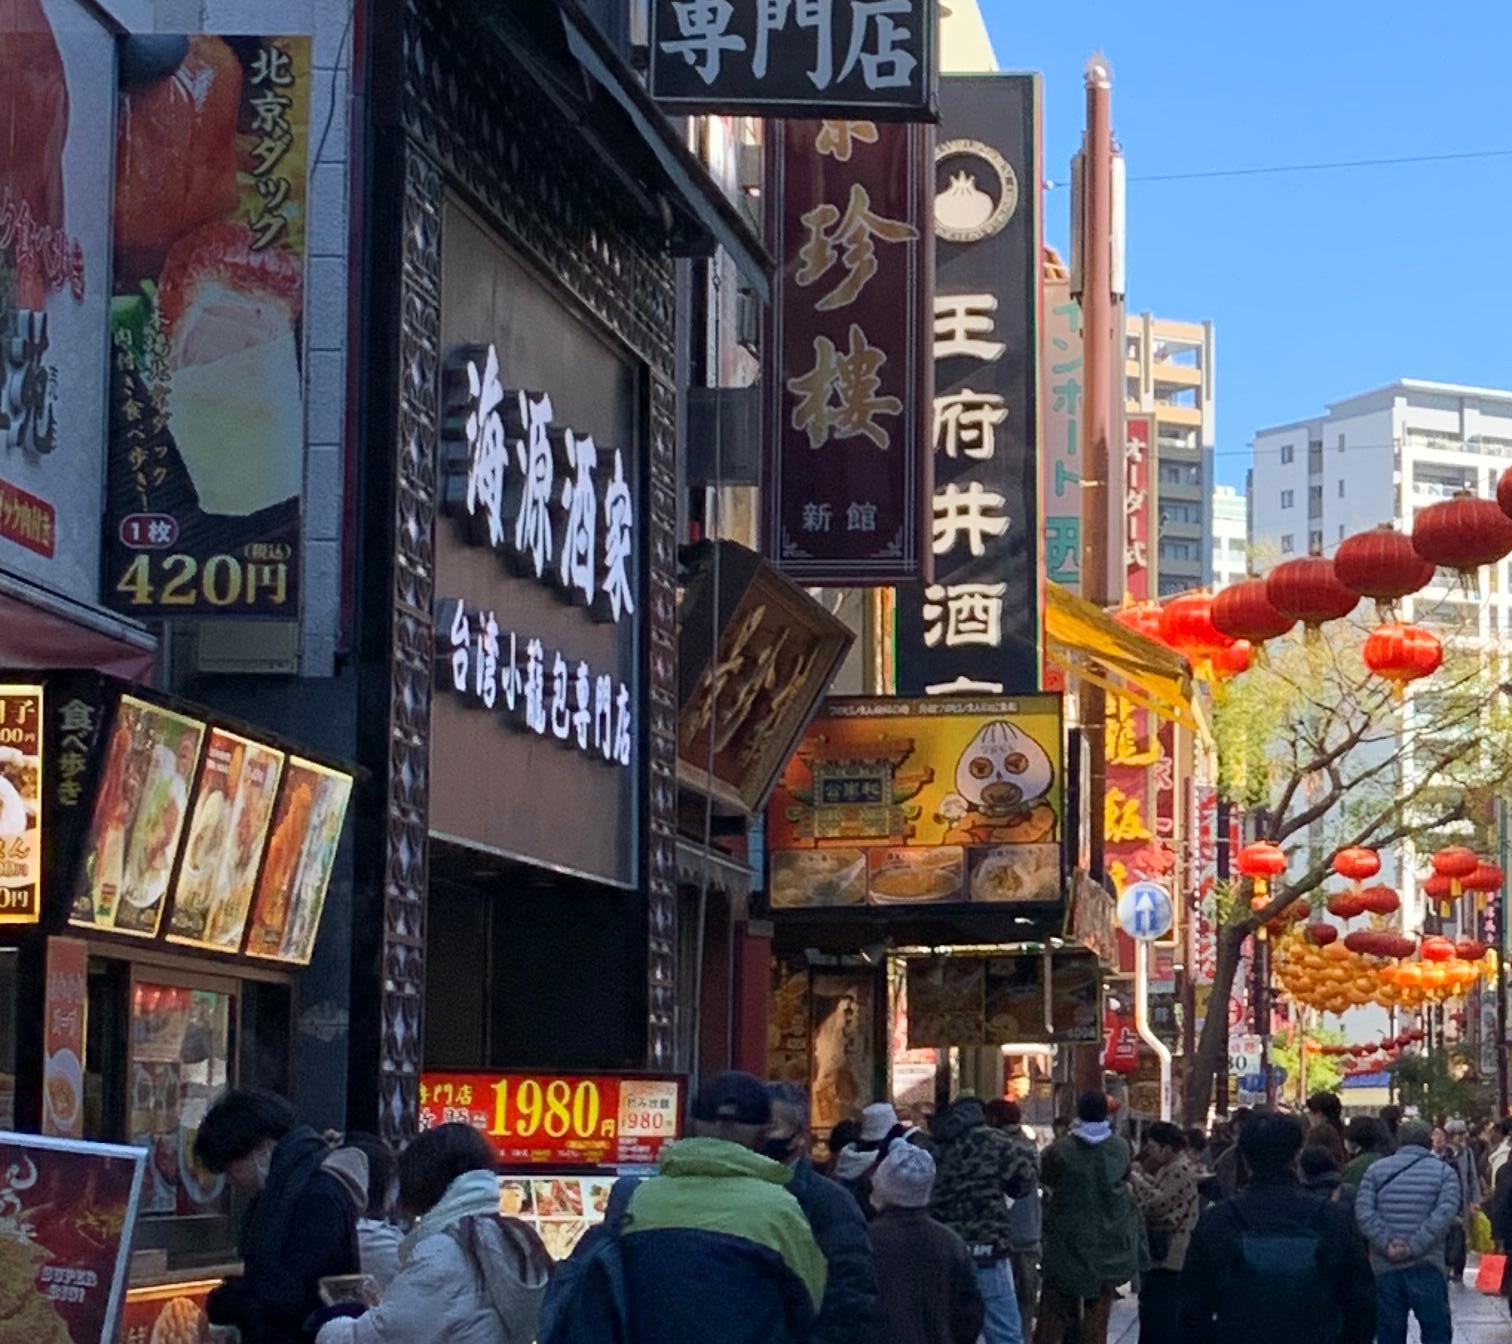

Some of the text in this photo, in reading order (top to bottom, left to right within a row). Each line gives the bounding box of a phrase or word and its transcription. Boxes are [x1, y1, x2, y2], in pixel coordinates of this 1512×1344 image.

[249, 48, 293, 250] 北京ダック
[130, 522, 172, 544] 1枚
[802, 501, 878, 533] 新館
[117, 554, 288, 605] 420円
[451, 599, 632, 766] 台湾小籠包専門店
[57, 699, 96, 806] 食べ歩き
